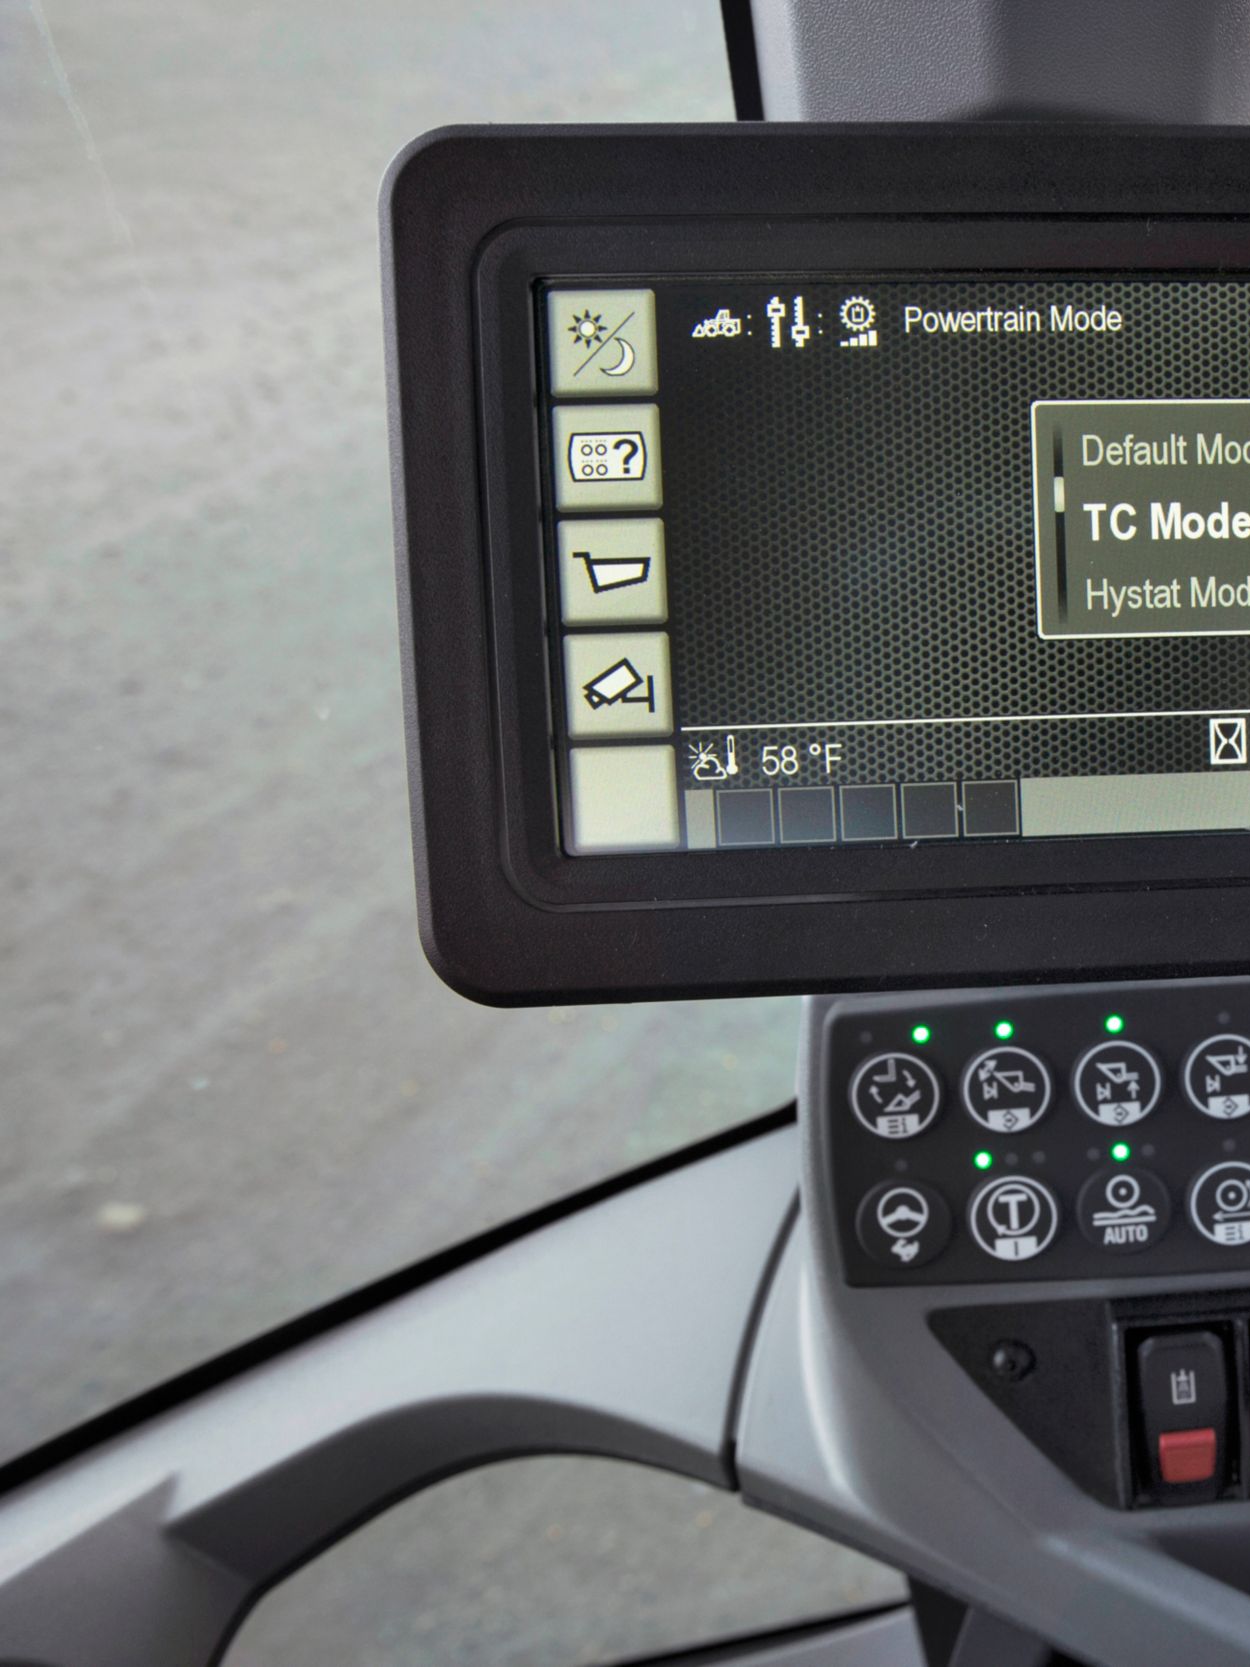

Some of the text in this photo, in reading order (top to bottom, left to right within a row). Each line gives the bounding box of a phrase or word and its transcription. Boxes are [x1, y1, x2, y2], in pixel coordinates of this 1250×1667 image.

[904, 304, 1123, 333] Powertrain Mode
[1082, 433, 1188, 466] Default
[1083, 502, 1137, 541] TC
[1086, 577, 1182, 618] Hystat
[762, 745, 799, 776] 58
[1103, 1223, 1149, 1246] AUTO
